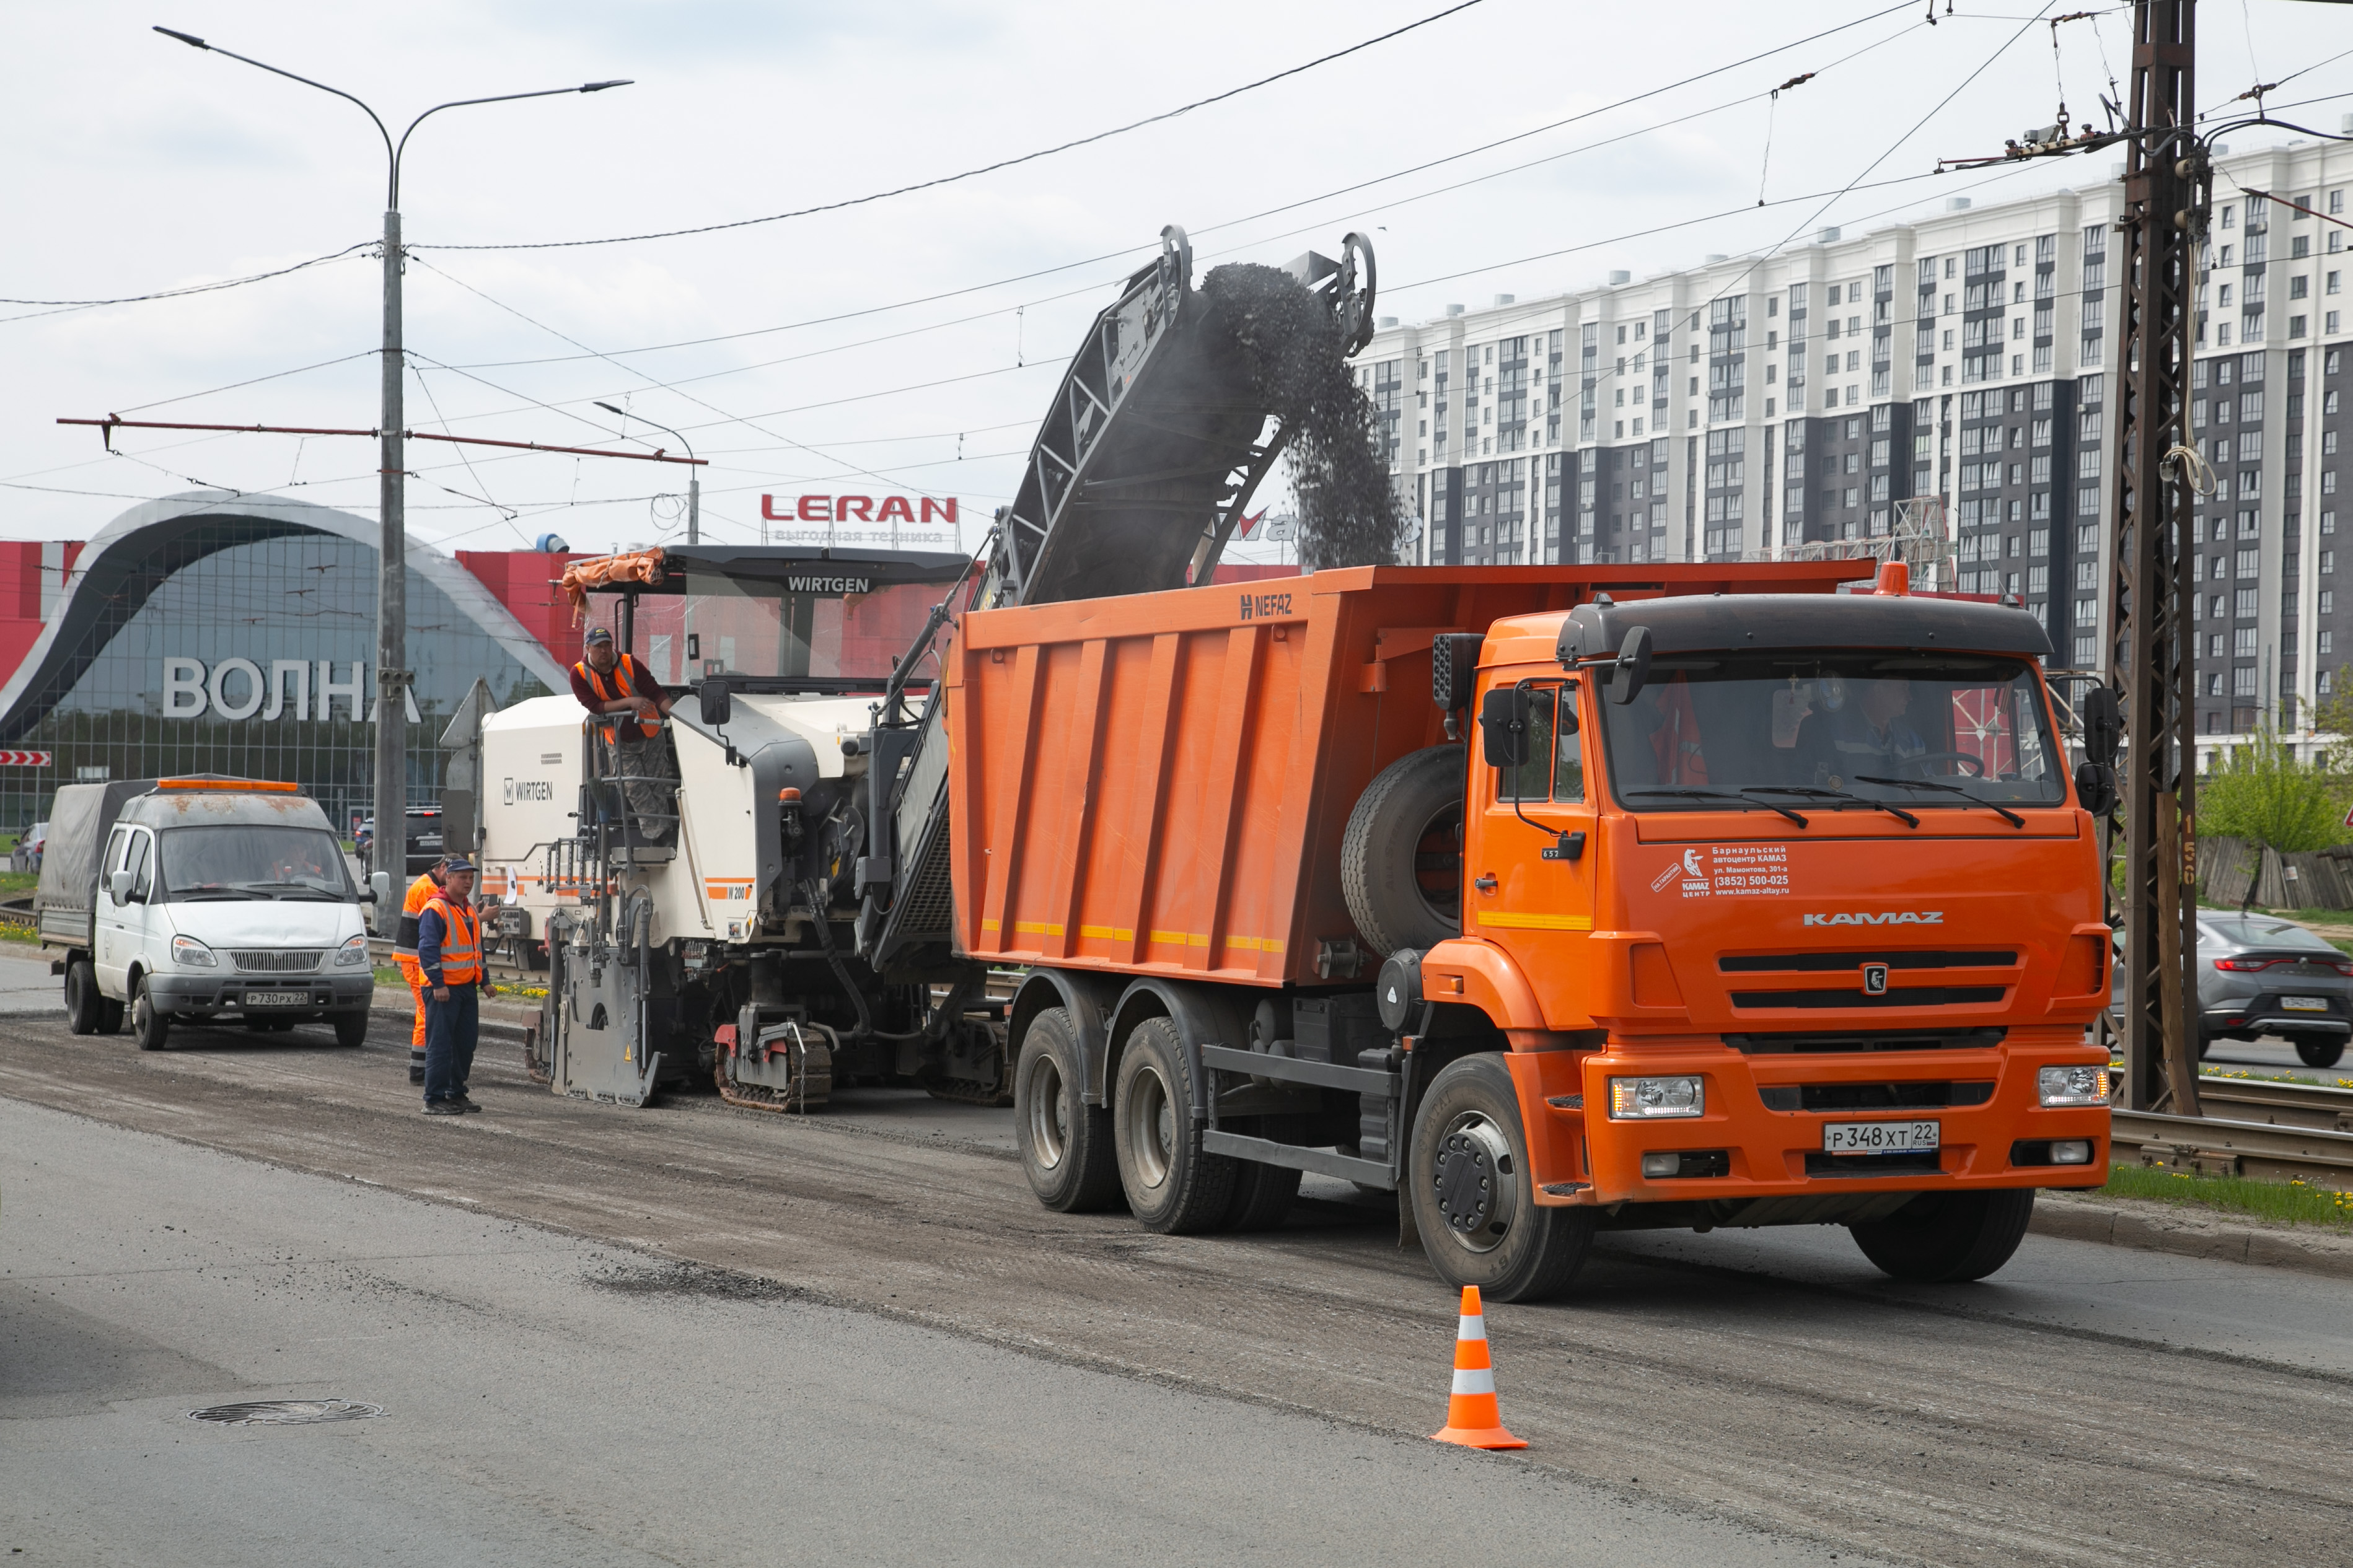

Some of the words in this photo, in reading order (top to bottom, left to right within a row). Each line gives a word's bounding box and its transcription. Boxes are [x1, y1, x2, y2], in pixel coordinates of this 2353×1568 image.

[762, 494, 957, 523] LERAN
[775, 530, 862, 544] выгодная
[869, 531, 943, 543] техника
[788, 576, 869, 593] WIRTGEN
[1256, 593, 1292, 616] NEFAZ
[516, 781, 552, 801] WIRTGEN
[1712, 846, 1786, 855] Барнаульский
[1659, 865, 1679, 885] ГАРАНТИИ
[1715, 876, 1746, 888] (3852)
[1749, 875, 1788, 885] 500-025
[1682, 882, 1710, 890] KAMAZ
[1715, 887, 1790, 895] www.kamaz-altay.ru
[728, 887, 734, 900] W
[734, 887, 744, 900] 200
[1804, 912, 1943, 926] KAMAZ
[294, 992, 304, 1001] 22
[1422, 1089, 1452, 1136] YATAI
[1914, 1124, 1932, 1139] 22
